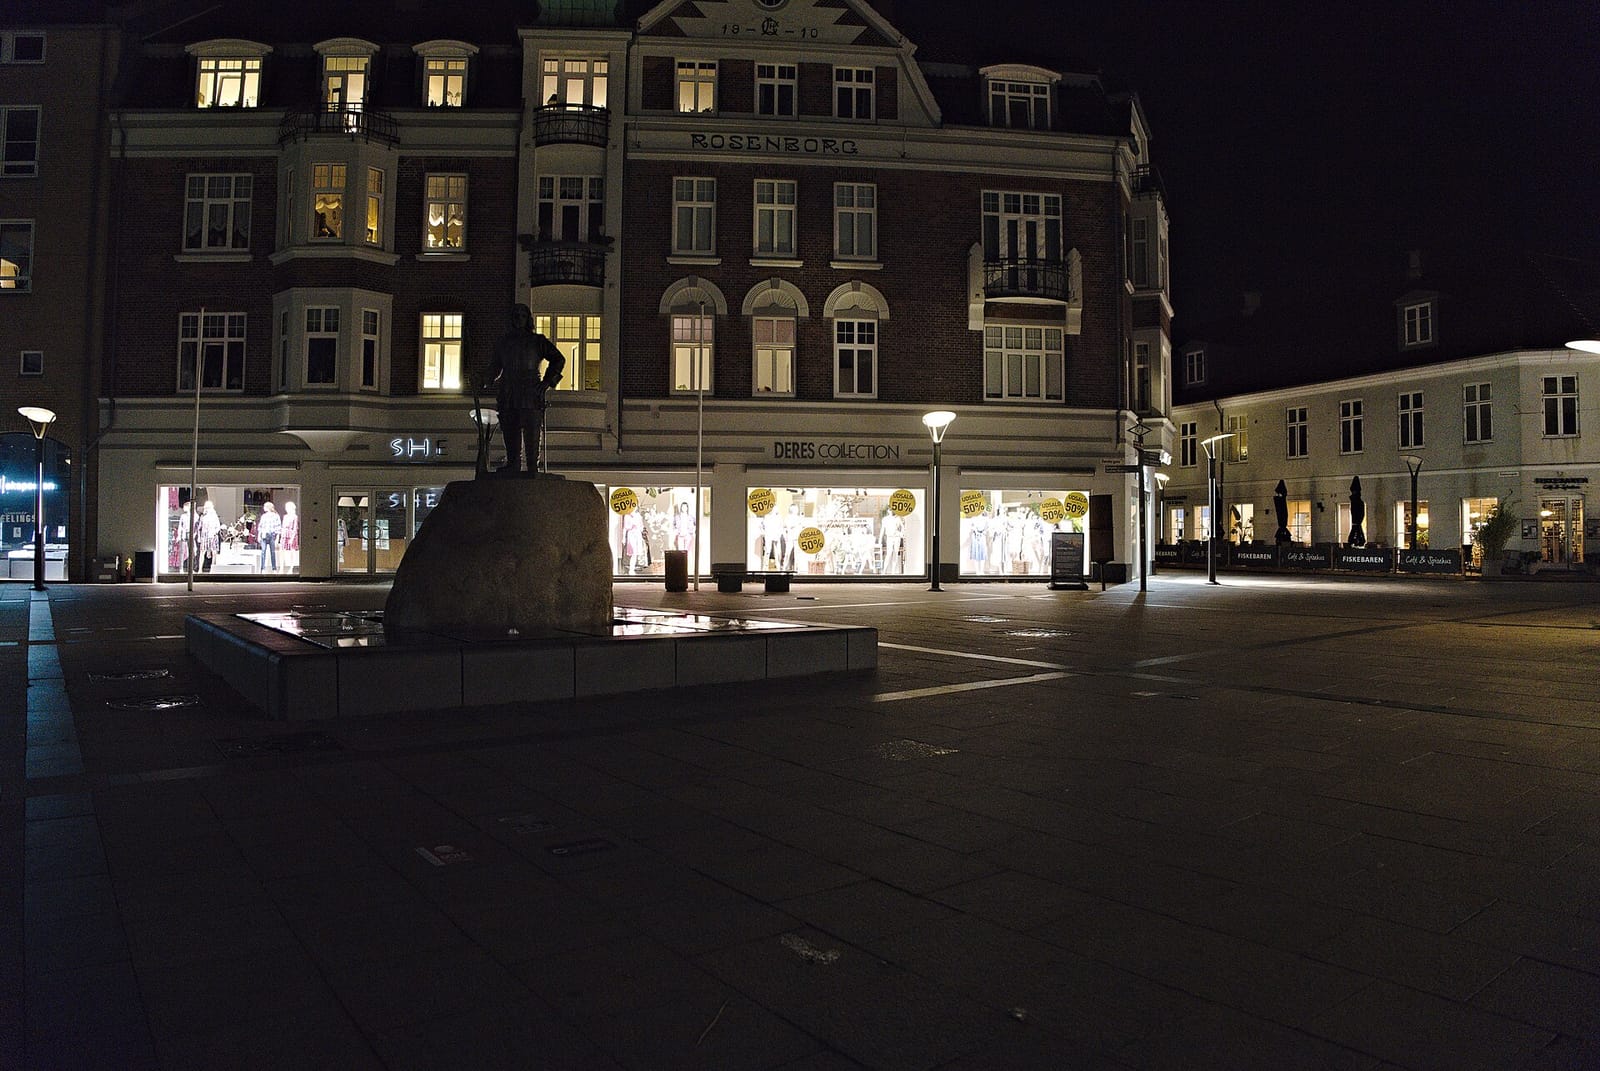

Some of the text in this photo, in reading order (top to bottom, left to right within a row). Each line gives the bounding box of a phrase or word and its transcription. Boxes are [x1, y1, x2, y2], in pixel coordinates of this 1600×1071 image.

[691, 133, 858, 154] ROSENBORG
[390, 437, 449, 457] SHE
[774, 442, 899, 459] DERES COLLECTION
[613, 499, 637, 513] 50%
[751, 499, 774, 513] 50%
[891, 501, 913, 513] 50%
[963, 501, 985, 514] 50%
[1065, 502, 1086, 516] 50%
[1042, 510, 1064, 521] 50%
[801, 539, 824, 551] 50%
[1237, 552, 1272, 560] FISKEBAREN
[1342, 555, 1384, 564] FISKEBAREN
